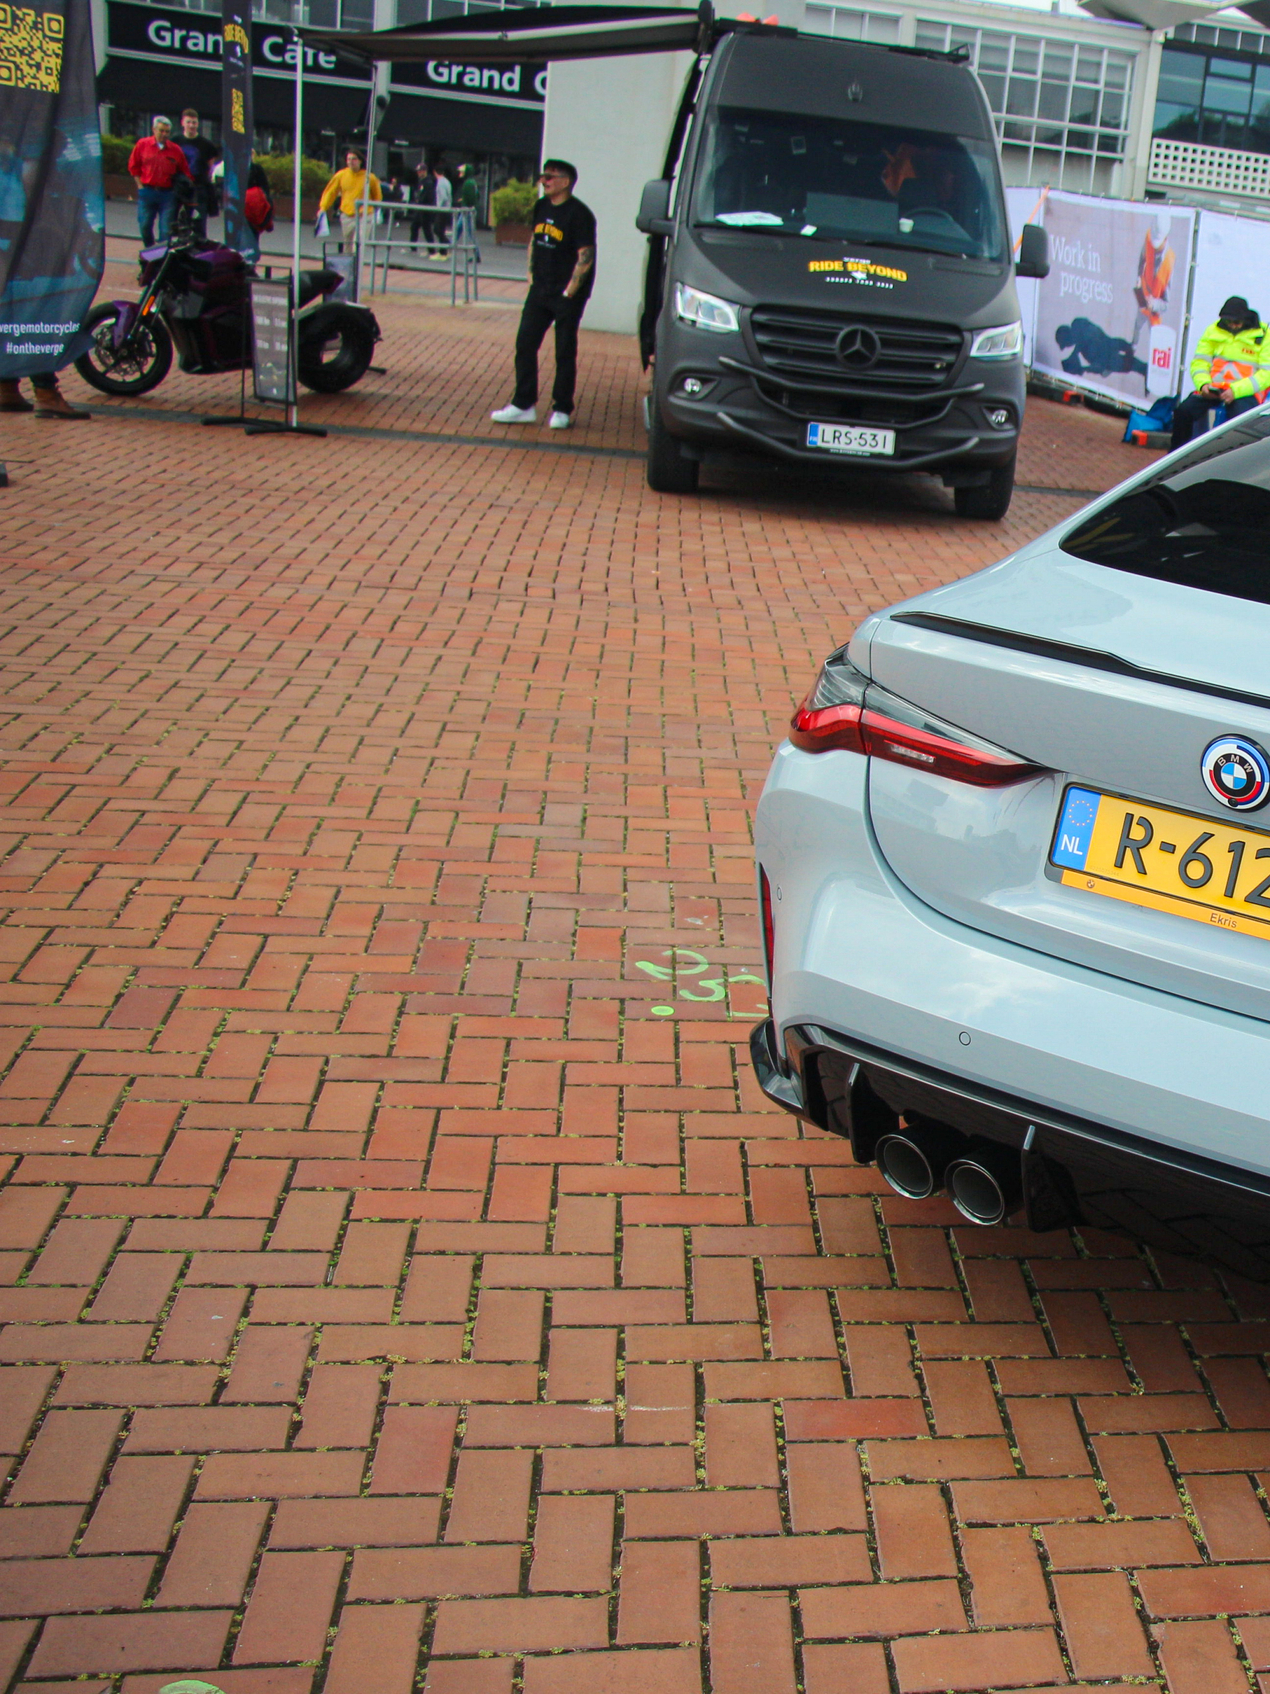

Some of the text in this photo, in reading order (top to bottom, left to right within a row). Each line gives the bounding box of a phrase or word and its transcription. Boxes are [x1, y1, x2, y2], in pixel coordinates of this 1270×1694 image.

[147, 19, 223, 54] Gran
[426, 60, 521, 93] Grand
[1050, 234, 1101, 273] Work in
[808, 260, 908, 282] RIDE BEYOND
[1060, 271, 1114, 304] progress
[6, 341, 65, 356] #ontheverge
[1152, 346, 1172, 369] rai
[1217, 754, 1254, 773] BMW
[1061, 834, 1083, 856] NL
[1209, 912, 1237, 929] Ekris
